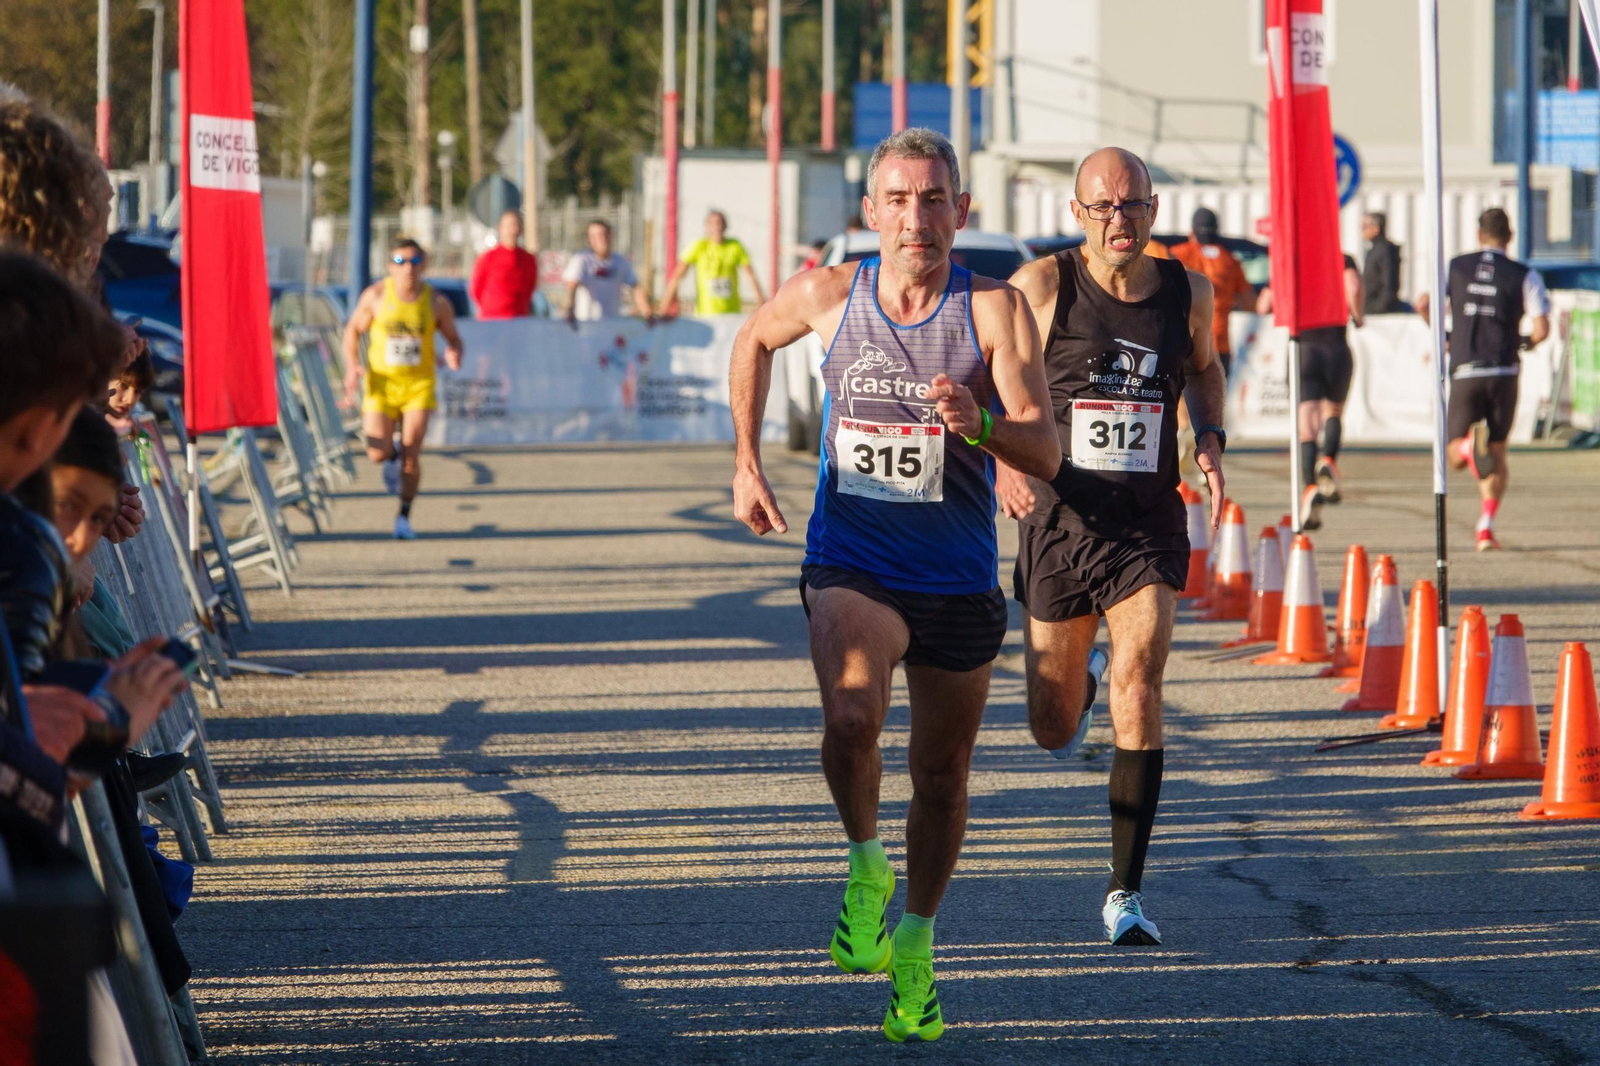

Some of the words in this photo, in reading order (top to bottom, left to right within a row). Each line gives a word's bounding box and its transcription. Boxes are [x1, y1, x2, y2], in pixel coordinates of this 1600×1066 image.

[1300, 50, 1323, 69] DE
[202, 154, 219, 172] DE
[1098, 384, 1127, 395] ESCOLA
[1128, 387, 1139, 397] DE
[1141, 388, 1163, 398] teatro
[1089, 420, 1146, 450] 312
[853, 444, 922, 478] 315
